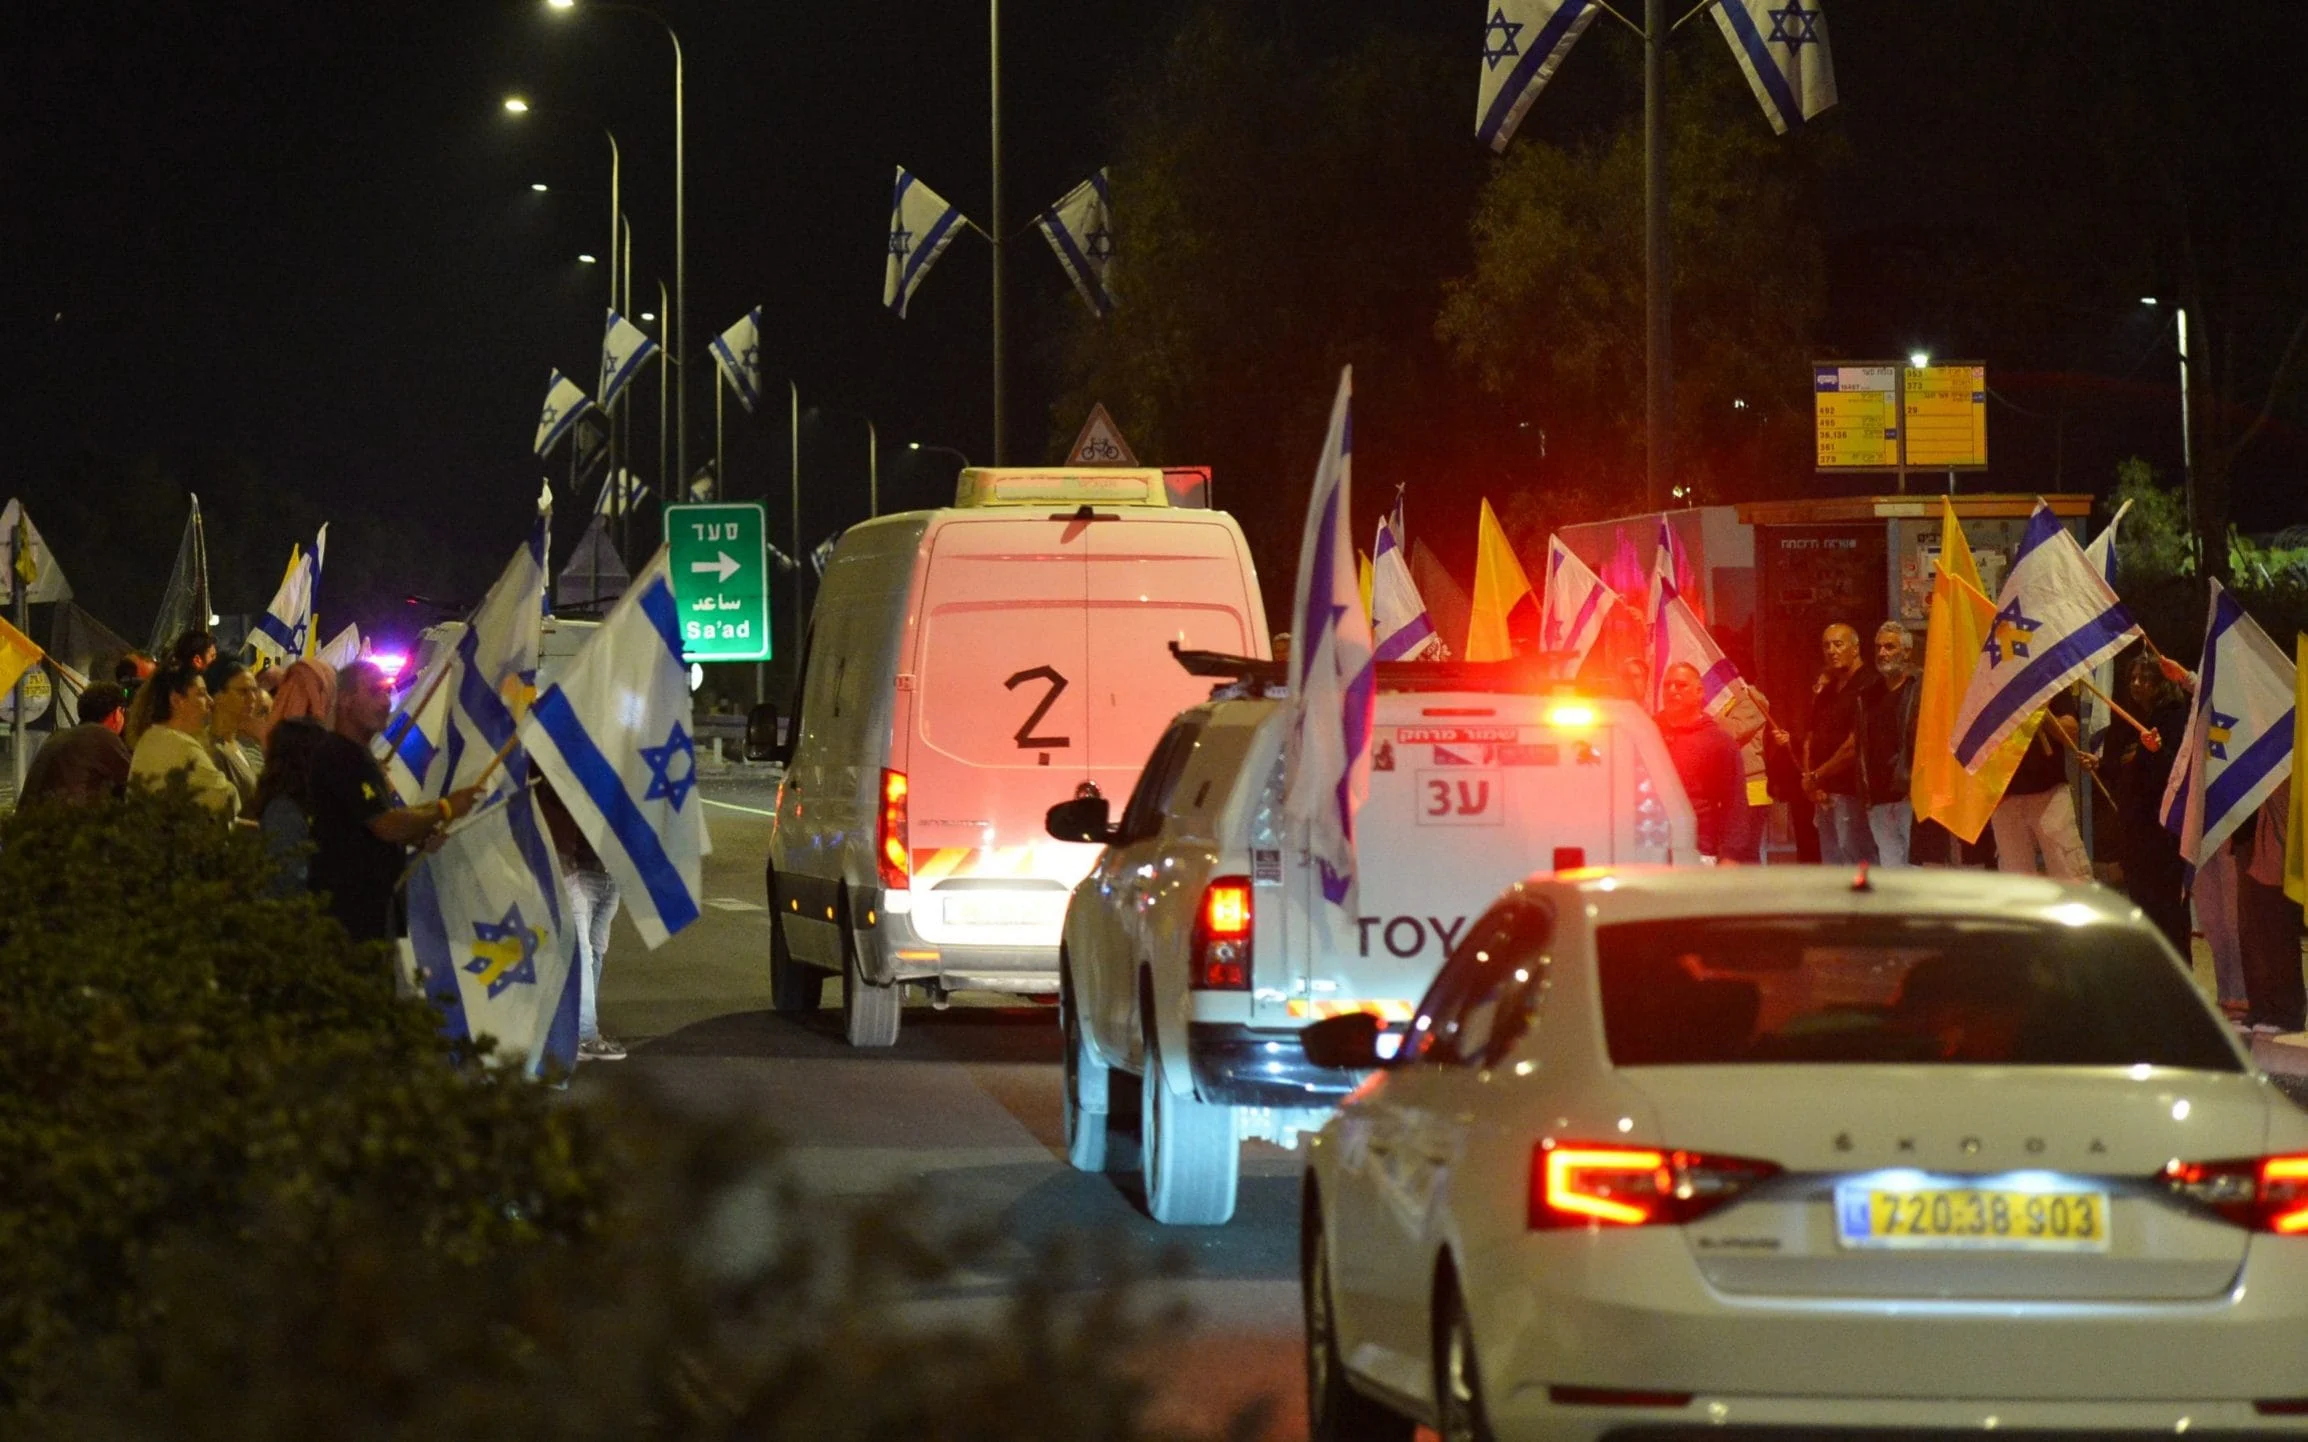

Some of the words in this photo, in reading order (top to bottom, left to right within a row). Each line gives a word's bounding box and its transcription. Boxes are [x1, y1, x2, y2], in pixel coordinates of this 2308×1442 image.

[690, 523, 739, 541] סעד
[692, 593, 741, 611] ساعد
[686, 619, 751, 640] Sa'ad
[1398, 728, 1457, 743] מרחק
